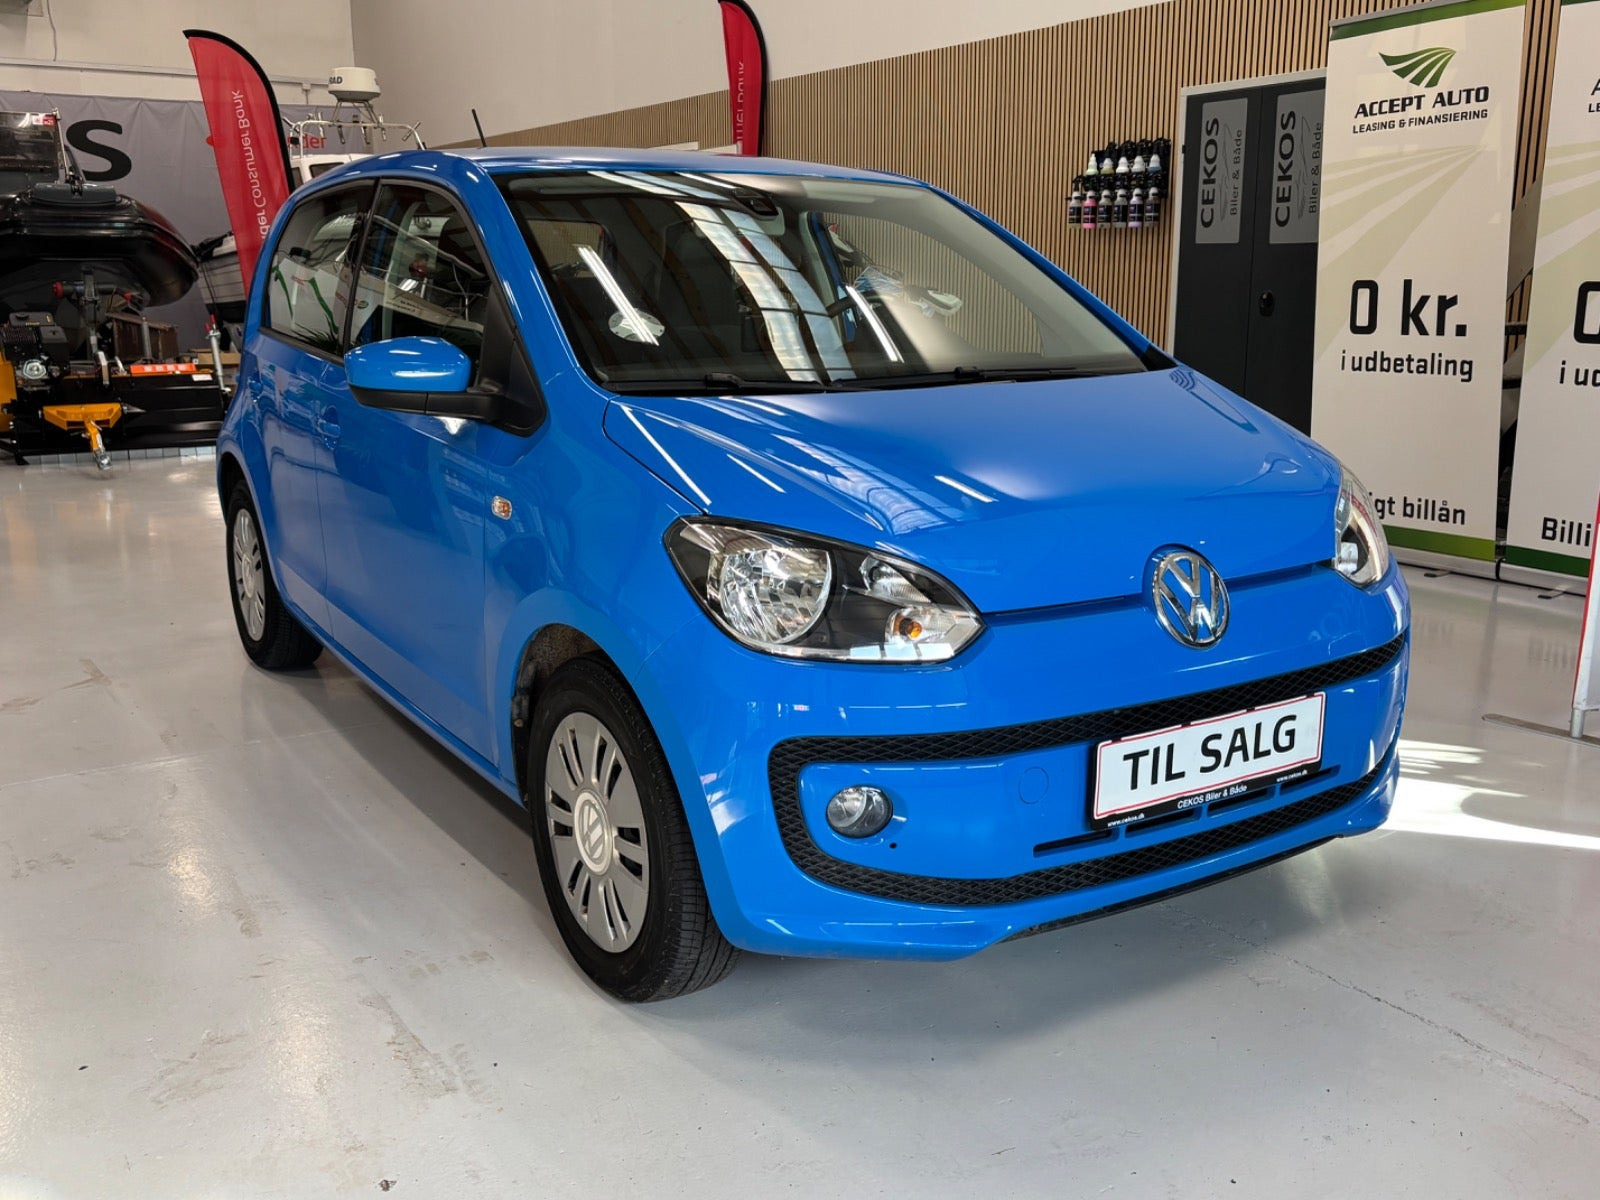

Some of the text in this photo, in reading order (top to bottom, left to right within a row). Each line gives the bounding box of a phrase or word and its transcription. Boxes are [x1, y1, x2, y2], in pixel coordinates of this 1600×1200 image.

[1354, 86, 1489, 119] ACCEPT AUTO
[1352, 109, 1488, 134] LEASING & FINANSIERING
[1200, 118, 1219, 228] CEKOS
[1230, 130, 1242, 215] Biler & Både
[1275, 111, 1296, 227] CEKOS
[1309, 182, 1318, 214] Biler
[1350, 279, 1467, 337] 0 kr.
[1341, 349, 1473, 383] i udbetaling
[1559, 360, 1566, 384] i
[1402, 496, 1466, 525] billån
[1123, 714, 1297, 791] TIL SALG
[1177, 794, 1204, 809] CEKOS
[1205, 791, 1221, 802] Biler
[1222, 789, 1228, 797] &
[1229, 784, 1247, 796] Både
